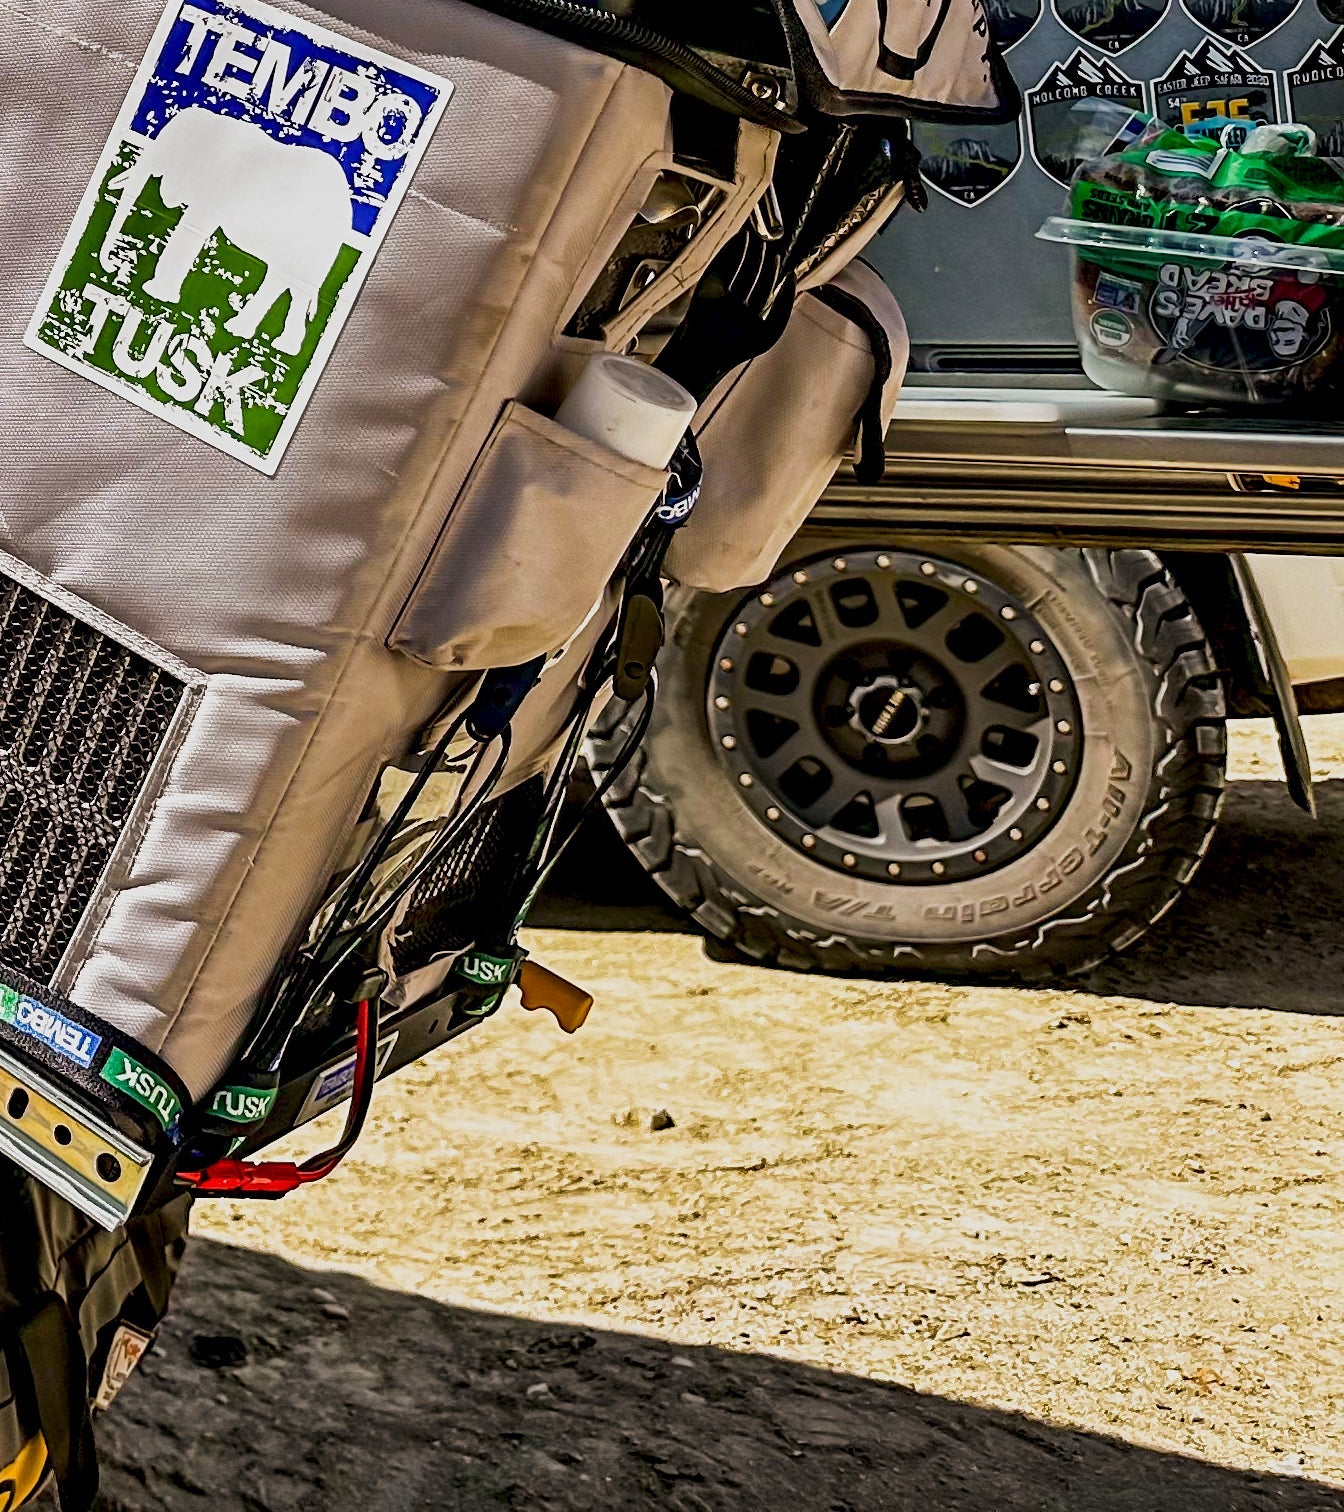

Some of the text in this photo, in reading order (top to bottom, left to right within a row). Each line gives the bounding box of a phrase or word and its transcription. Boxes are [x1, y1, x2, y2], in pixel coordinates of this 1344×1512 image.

[168, 4, 424, 161] TEMBO
[1160, 263, 1274, 301] BREAD
[1155, 289, 1268, 330] DAVE'S
[79, 283, 265, 437] TUSK
[463, 956, 508, 982] USK
[15, 1000, 98, 1065] TEMBO
[121, 1056, 182, 1122] TUSK
[212, 1090, 271, 1118] TUSK
